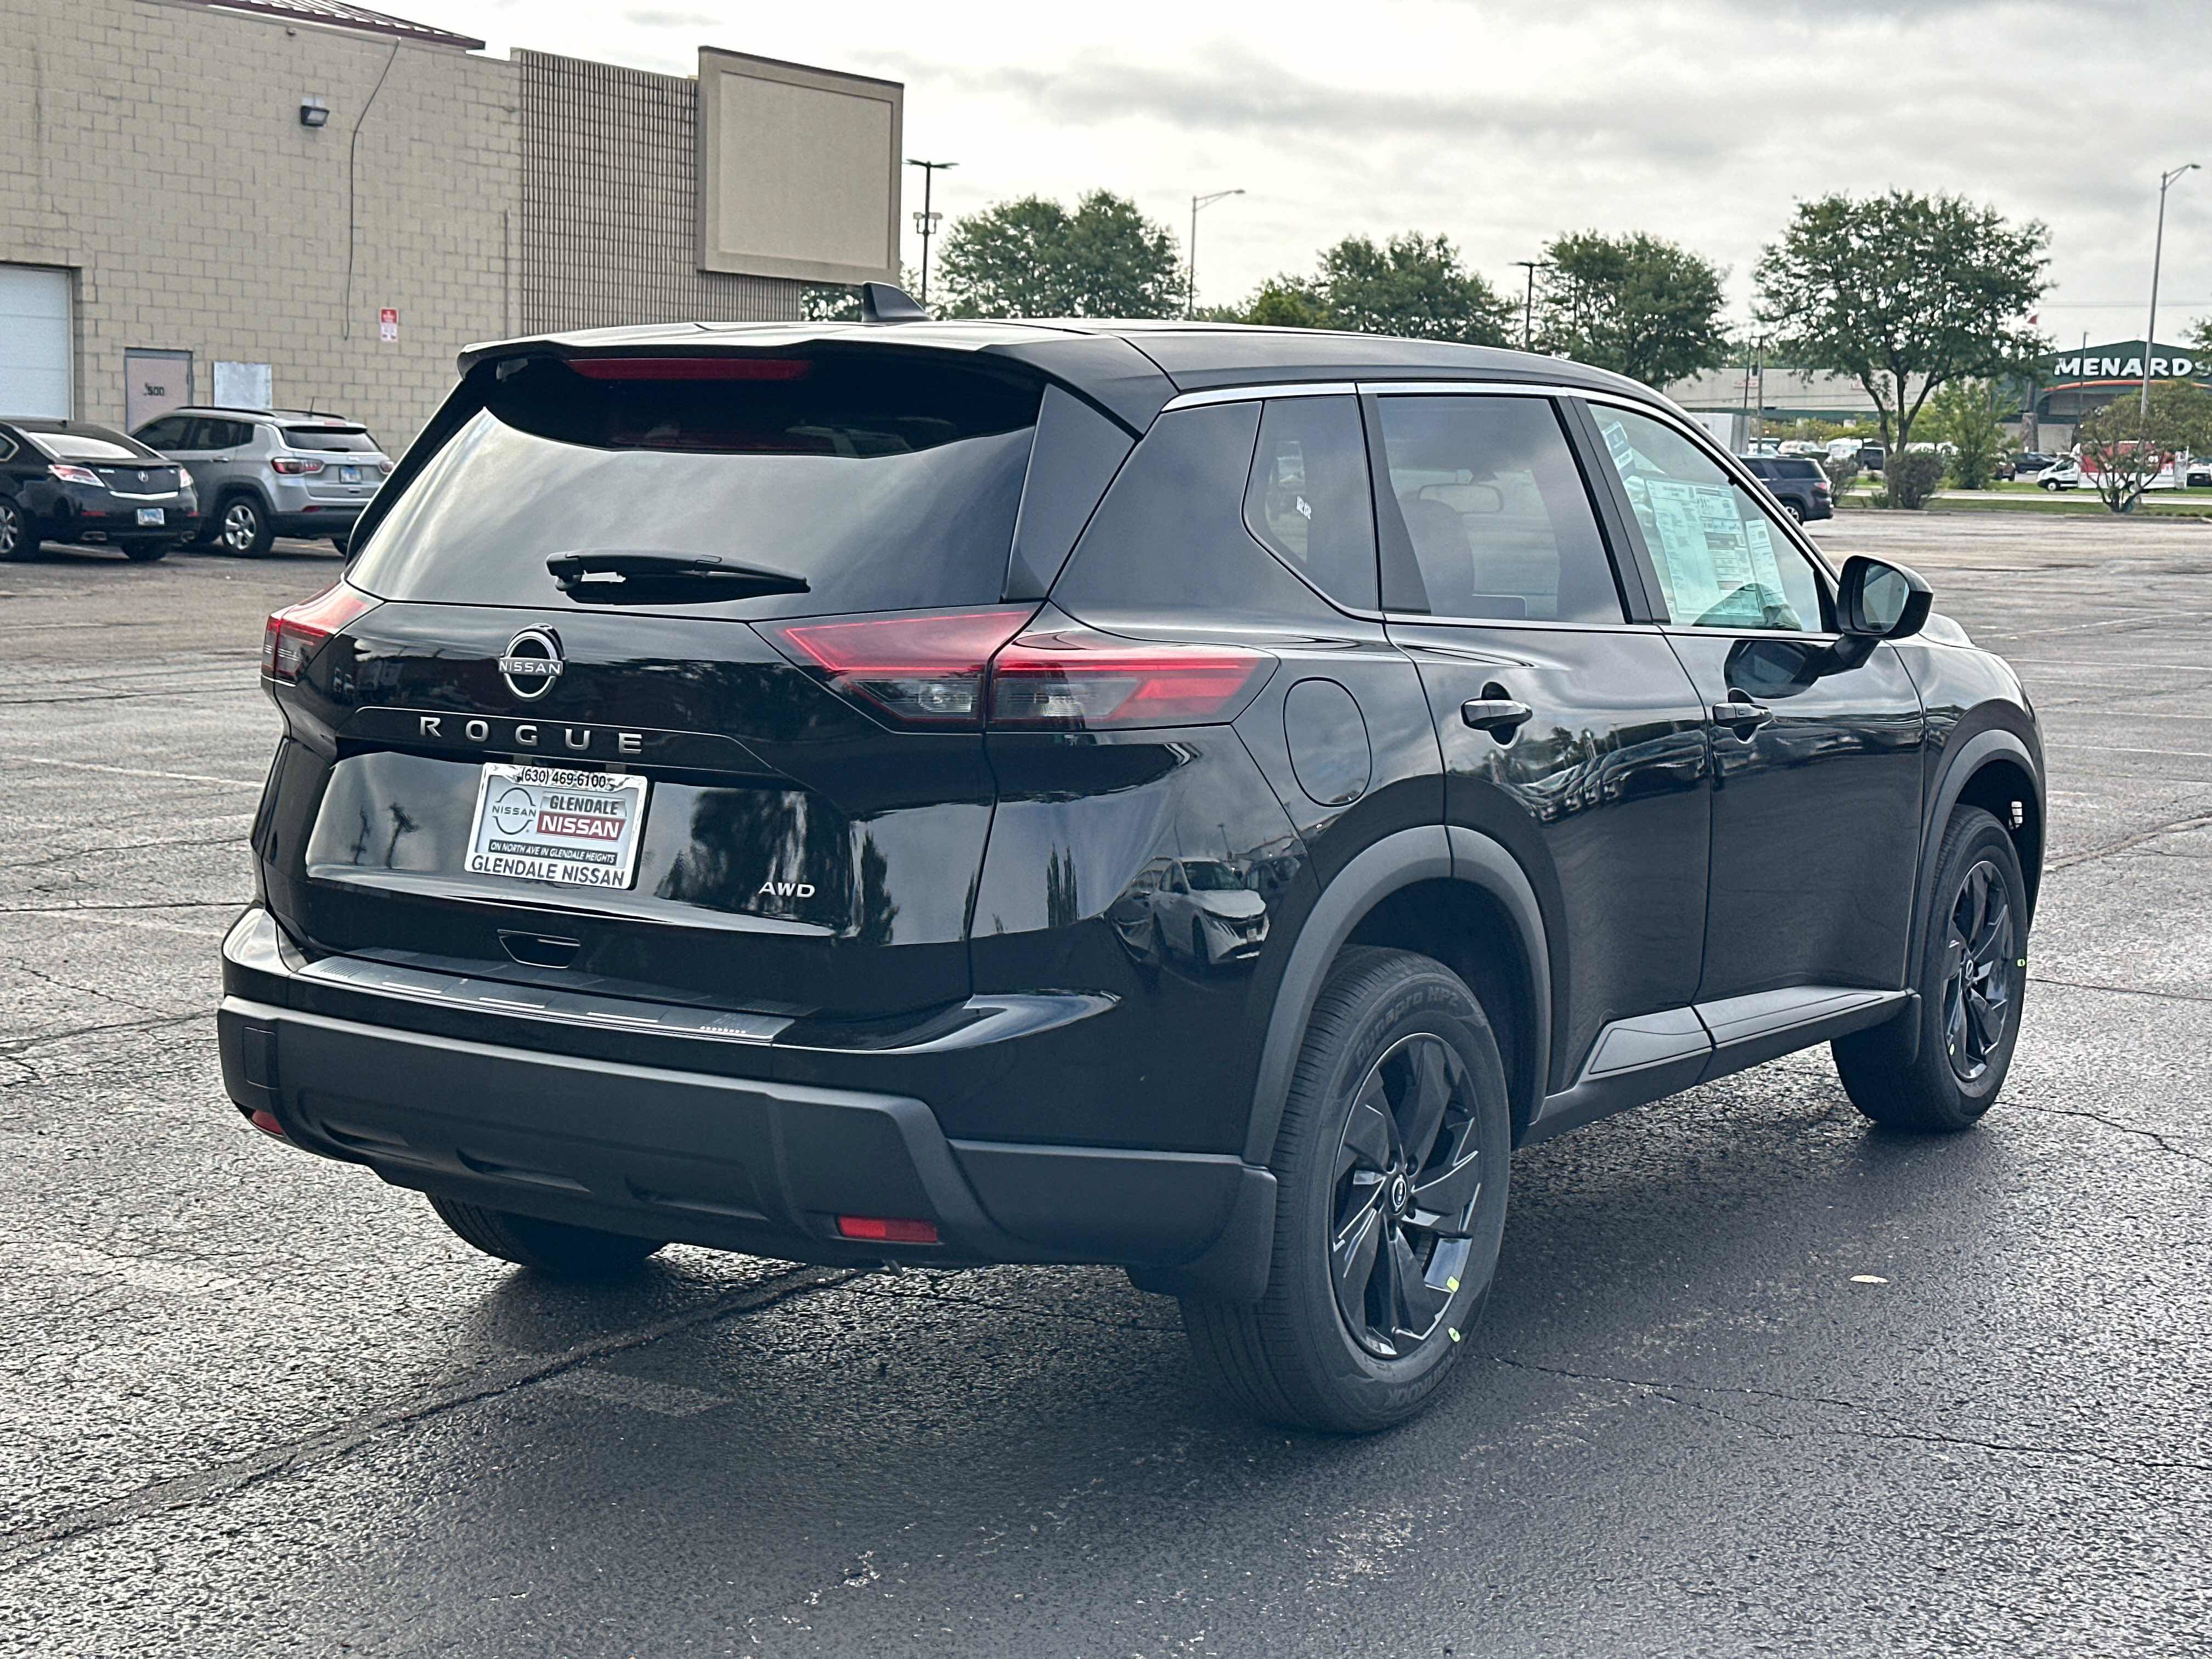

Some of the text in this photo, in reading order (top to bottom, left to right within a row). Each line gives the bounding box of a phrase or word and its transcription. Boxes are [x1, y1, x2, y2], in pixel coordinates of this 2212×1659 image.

[499, 659, 561, 675] NISSAN
[419, 716, 643, 754] ROGUE
[521, 768, 606, 788] (630) 469-6100
[492, 805, 537, 817] NISSAN
[549, 795, 619, 815] GLENDALE
[541, 813, 619, 838] NISSAN
[490, 841, 615, 864] ON NORTH AVE IN GLENDALE HEIGHTS
[472, 855, 625, 887] GLENDALE NISSAN
[758, 882, 816, 898] AWD
